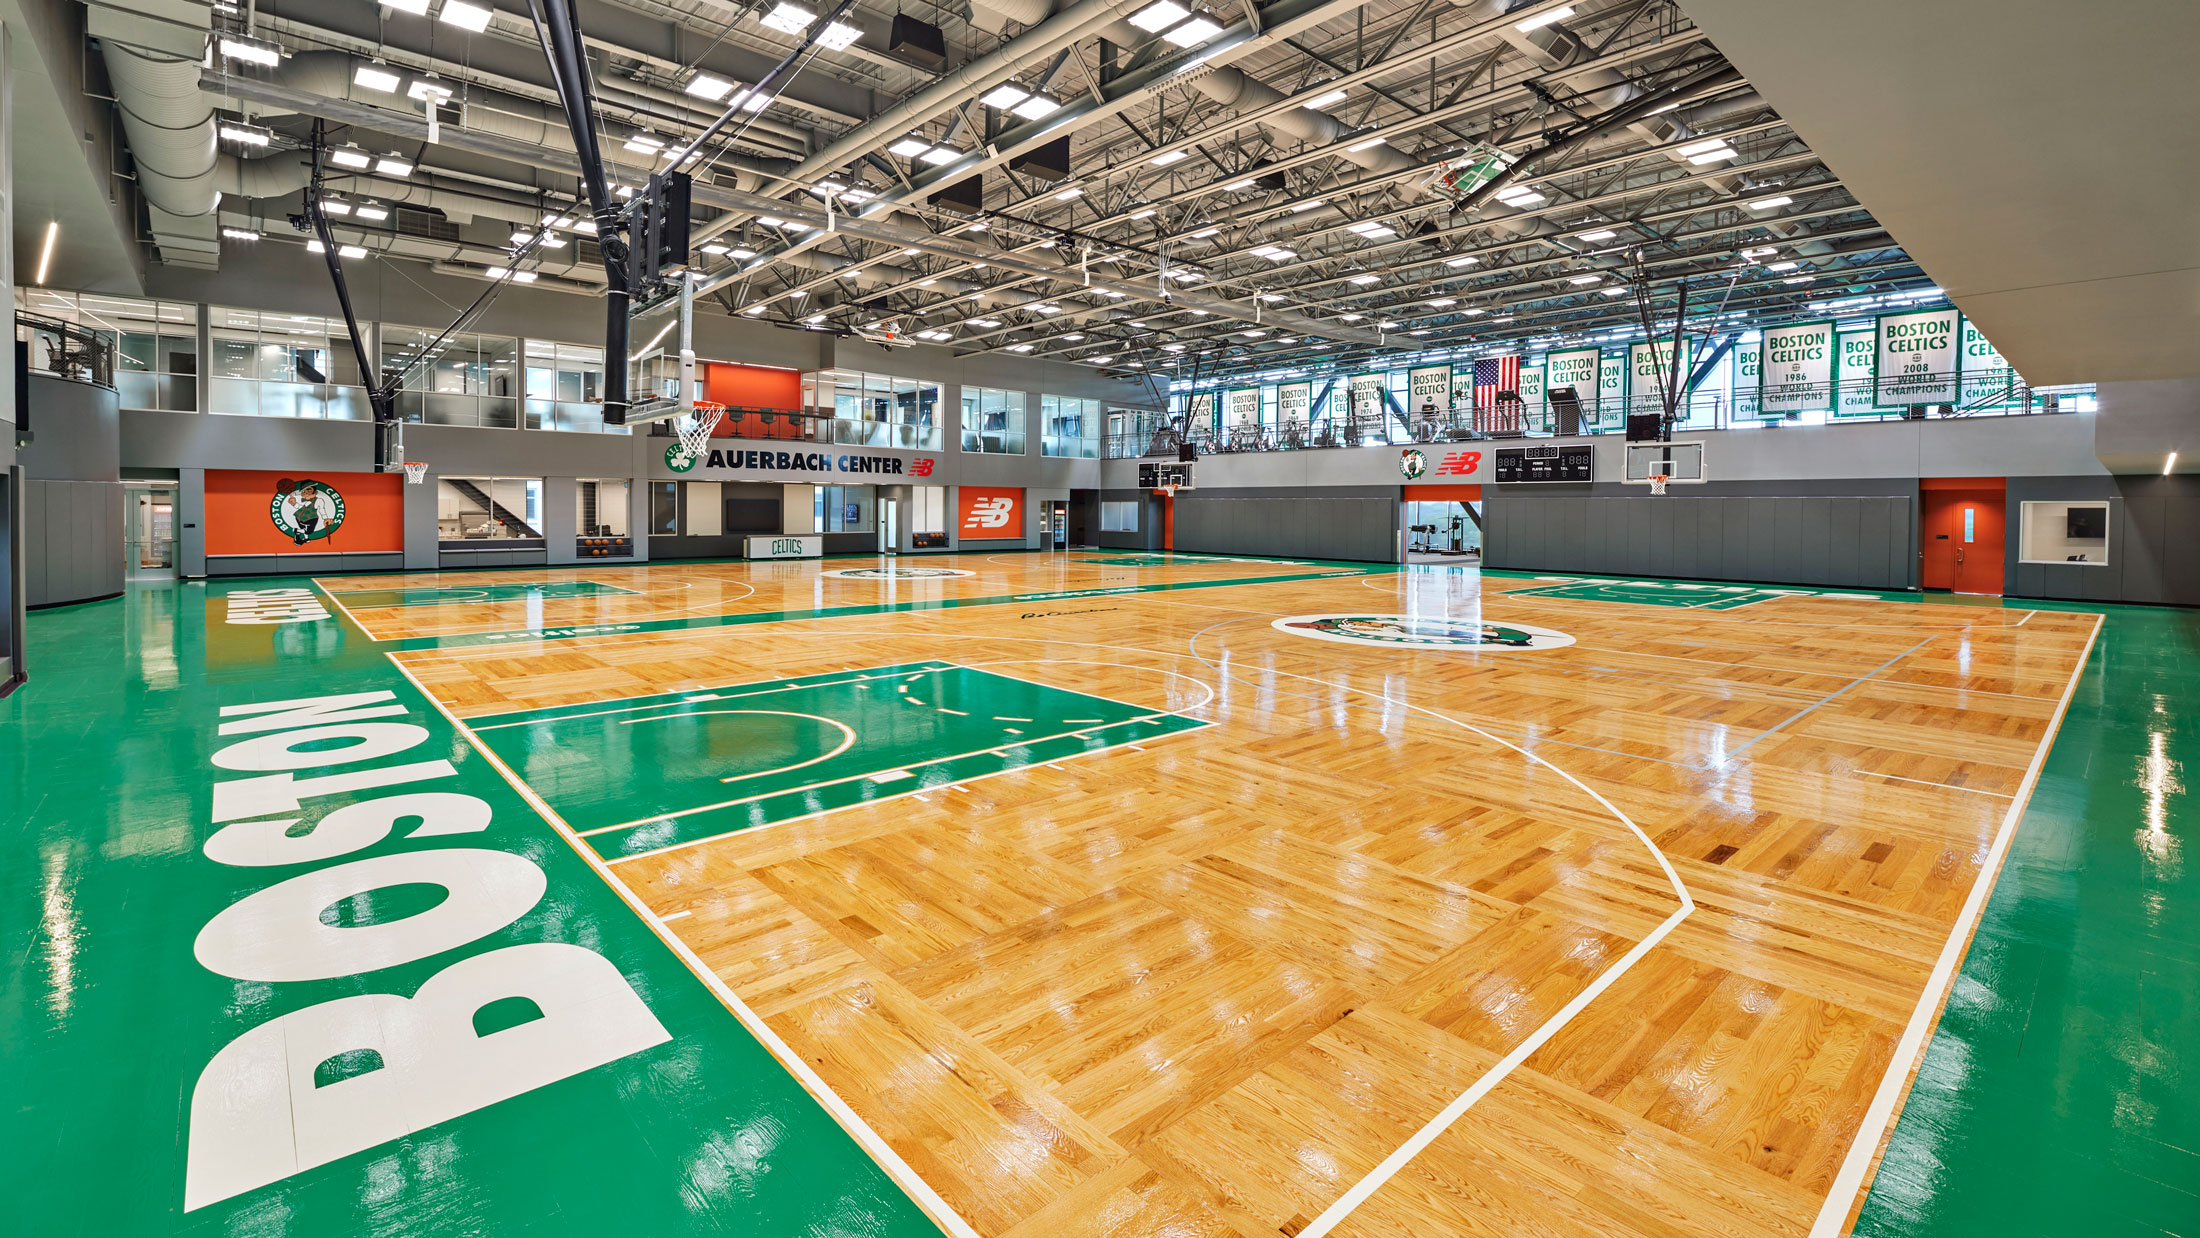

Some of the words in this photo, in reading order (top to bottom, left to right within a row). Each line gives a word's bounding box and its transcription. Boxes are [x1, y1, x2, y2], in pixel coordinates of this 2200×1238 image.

[1887, 320, 1951, 338] BOSTON
[1770, 333, 1825, 349] BOSTON
[1888, 336, 1948, 353] CELTICS
[1771, 347, 1823, 363] CELTICS
[1552, 357, 1593, 371] BOSTON
[1904, 364, 1929, 373] 2008
[1413, 372, 1447, 385] BOSTON
[1553, 370, 1592, 383] CELTICS
[1786, 373, 1807, 381] 1986
[1899, 373, 1936, 384] WORLD
[1352, 380, 1382, 392] BOSTON
[1414, 384, 1446, 396] CELTICS
[1885, 384, 1947, 395] CHAMPIONS
[1232, 394, 1257, 405] BOSTON
[1281, 389, 1308, 399] BOSTON
[1354, 391, 1381, 402] CELTICS
[1769, 391, 1823, 402] CHAMPIONS
[1233, 404, 1256, 413] CELTICS
[1281, 399, 1306, 409] CELTICS
[706, 449, 832, 472] AUERBACH
[837, 455, 903, 475] CENTER
[325, 487, 345, 524] CELTICS
[271, 493, 289, 532] BOSTON
[771, 539, 803, 555] CELTICS
[184, 690, 674, 1214] BOSTON
